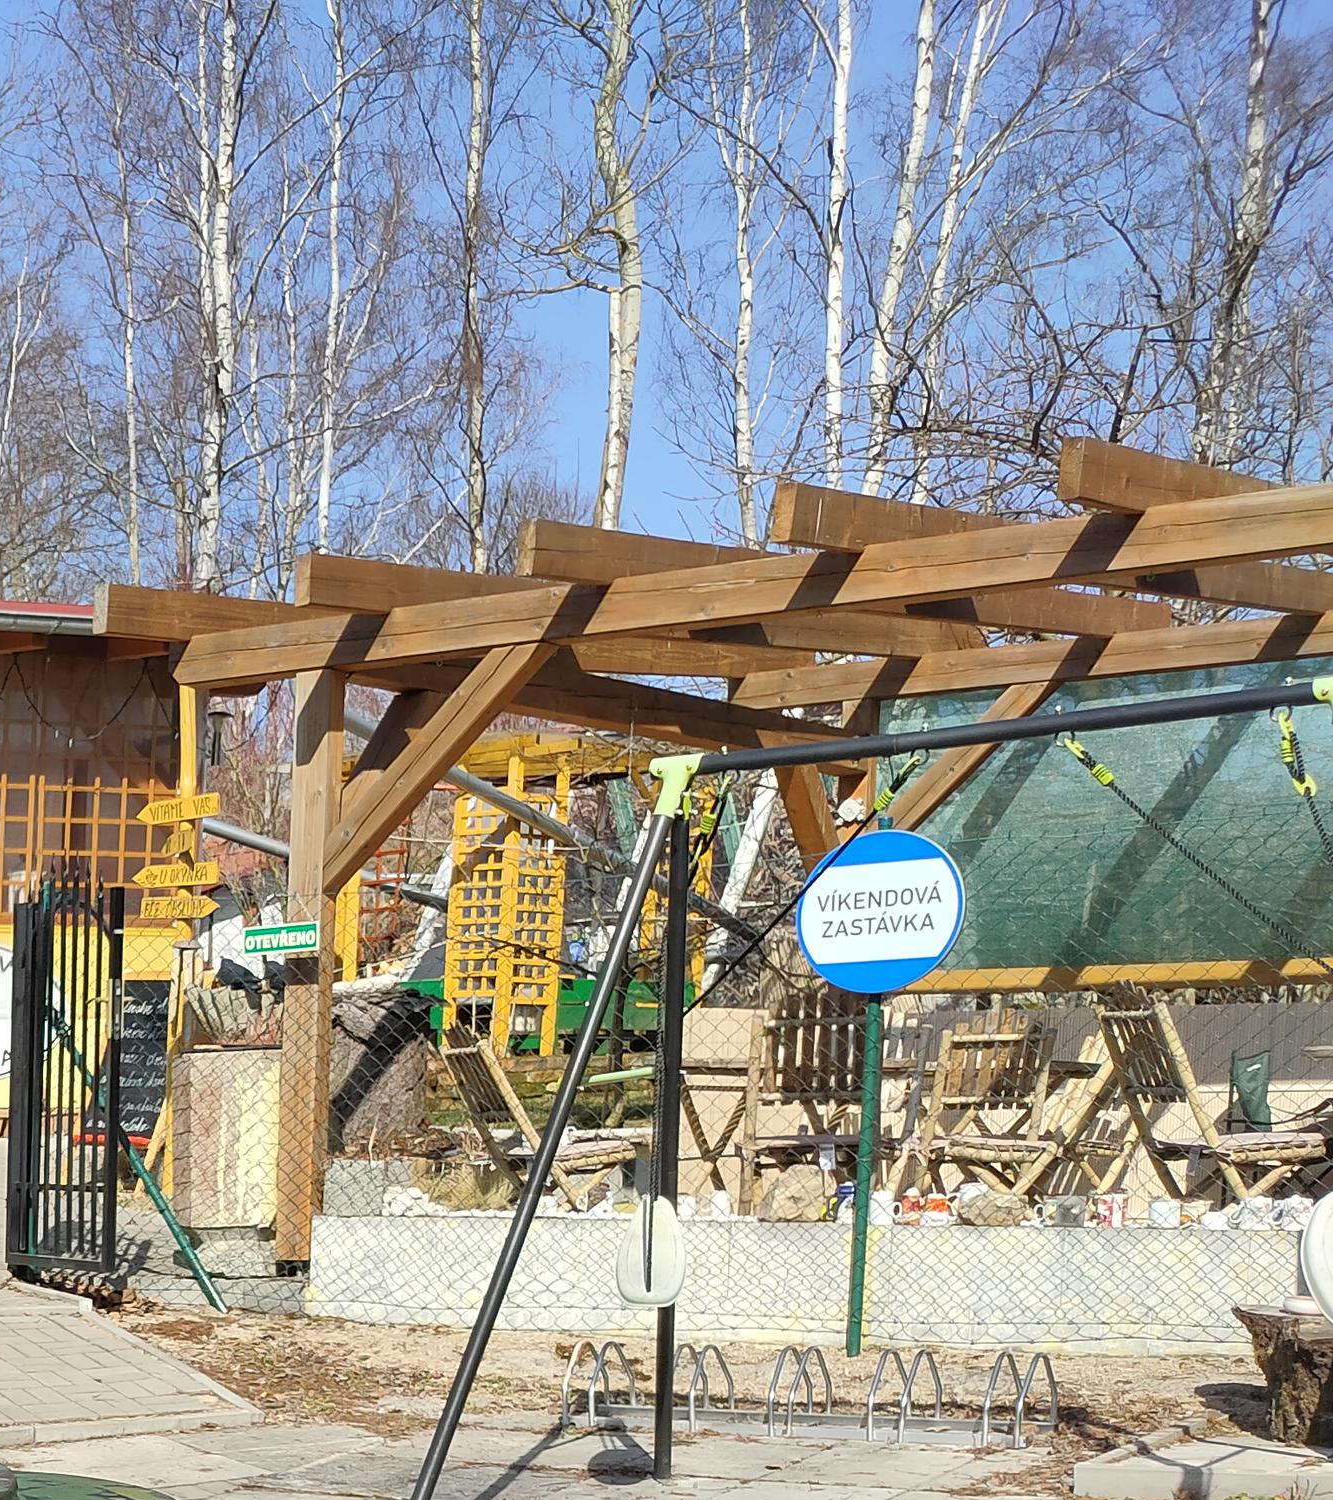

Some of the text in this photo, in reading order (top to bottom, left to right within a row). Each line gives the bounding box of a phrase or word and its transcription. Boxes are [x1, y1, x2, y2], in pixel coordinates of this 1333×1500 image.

[817, 880, 942, 912] VÍKENDOVÁ
[821, 911, 935, 938] ZASTÁVKA
[245, 929, 316, 951] OTEVŘENO
